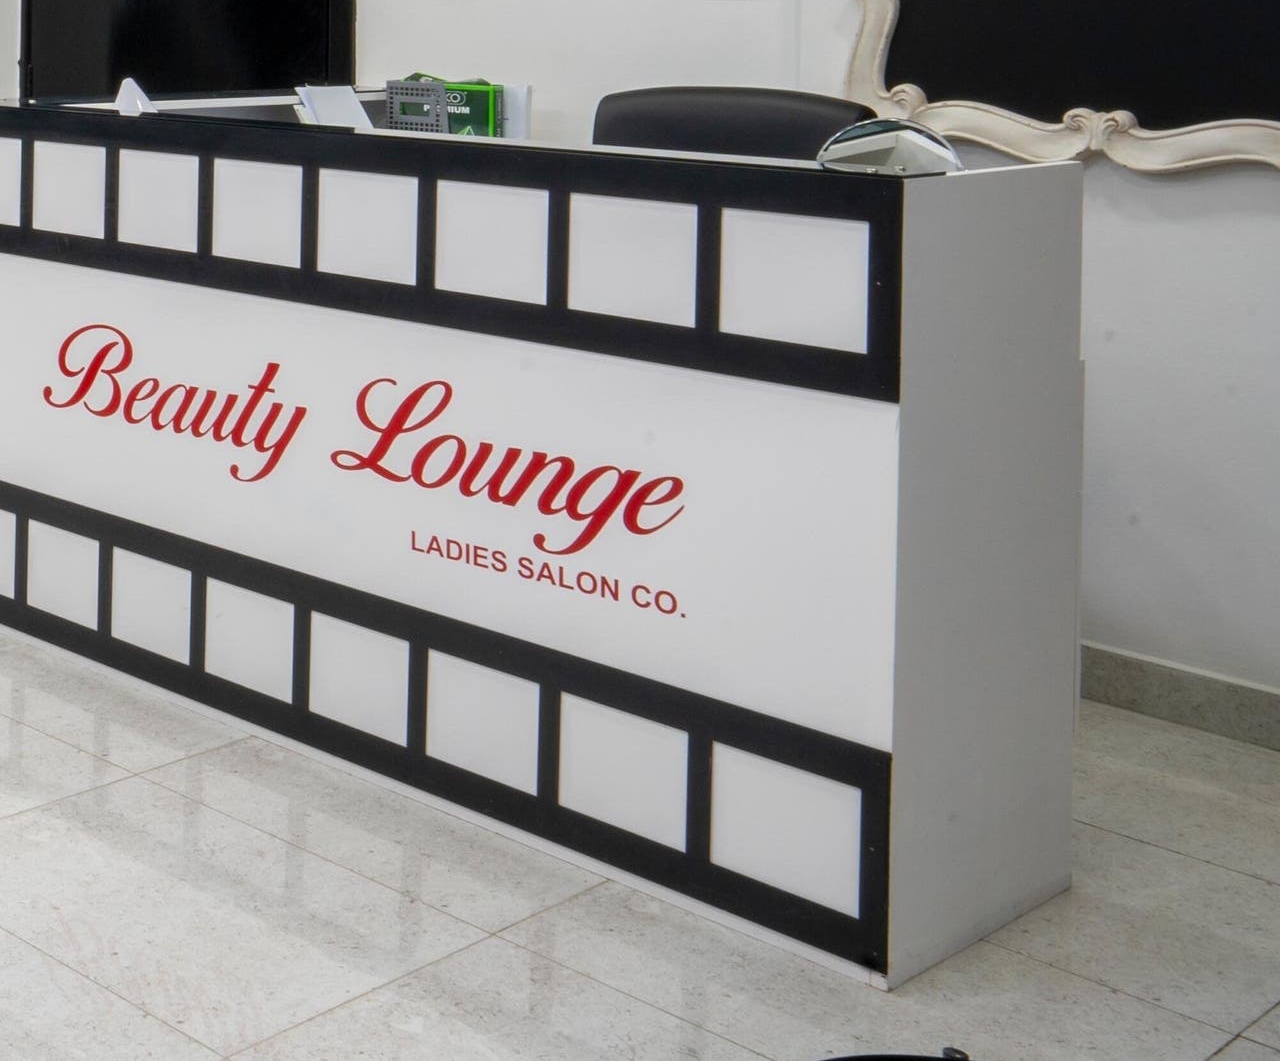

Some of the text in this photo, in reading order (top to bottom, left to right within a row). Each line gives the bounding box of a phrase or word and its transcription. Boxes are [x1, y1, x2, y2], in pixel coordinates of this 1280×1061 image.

[42, 323, 686, 556] Beauty Lounge
[410, 530, 688, 619] LADIES SALON CO.
